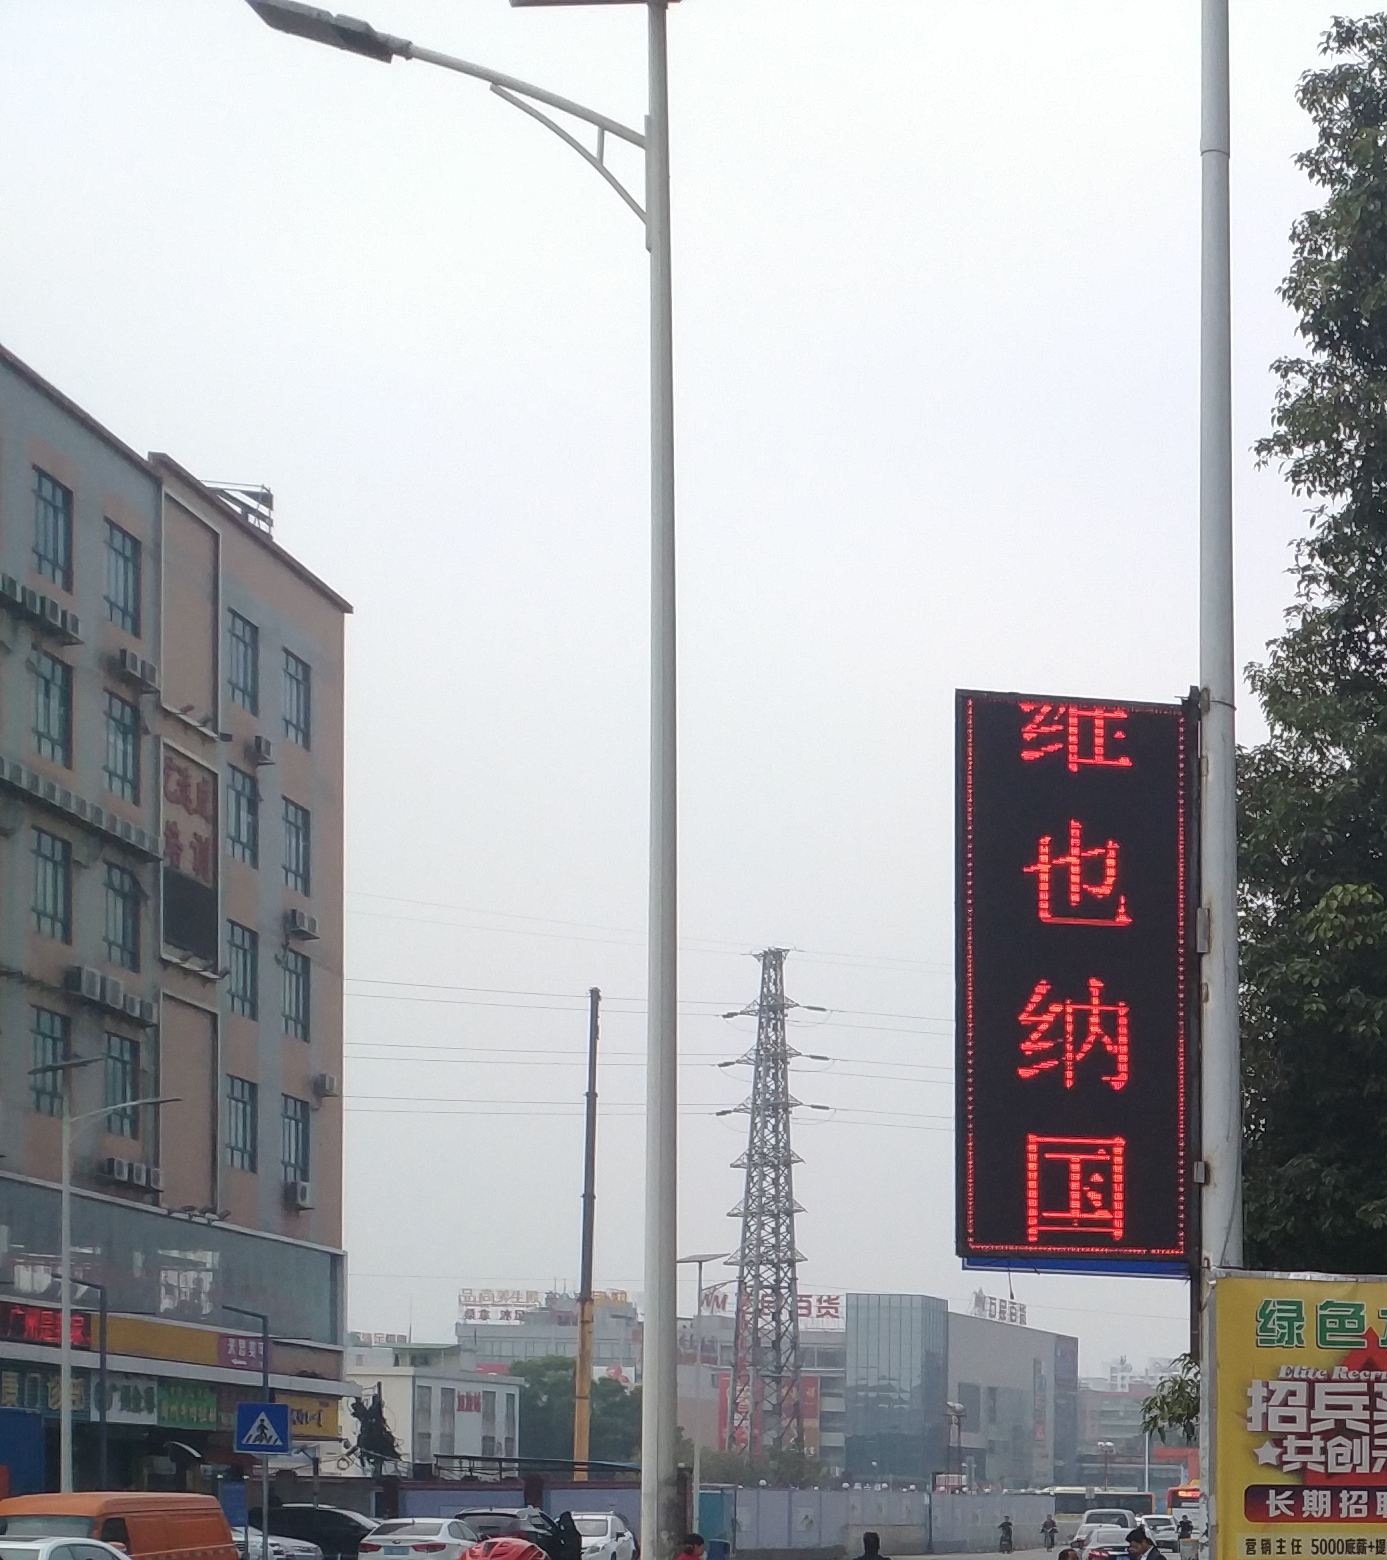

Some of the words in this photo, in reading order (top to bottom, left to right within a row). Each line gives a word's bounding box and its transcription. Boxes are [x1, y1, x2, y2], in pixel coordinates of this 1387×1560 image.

[1017, 702, 1132, 1242] 维也纳国
[1279, 1365, 1328, 1380] Elite
[1245, 1538, 1302, 1555] 营销主任
